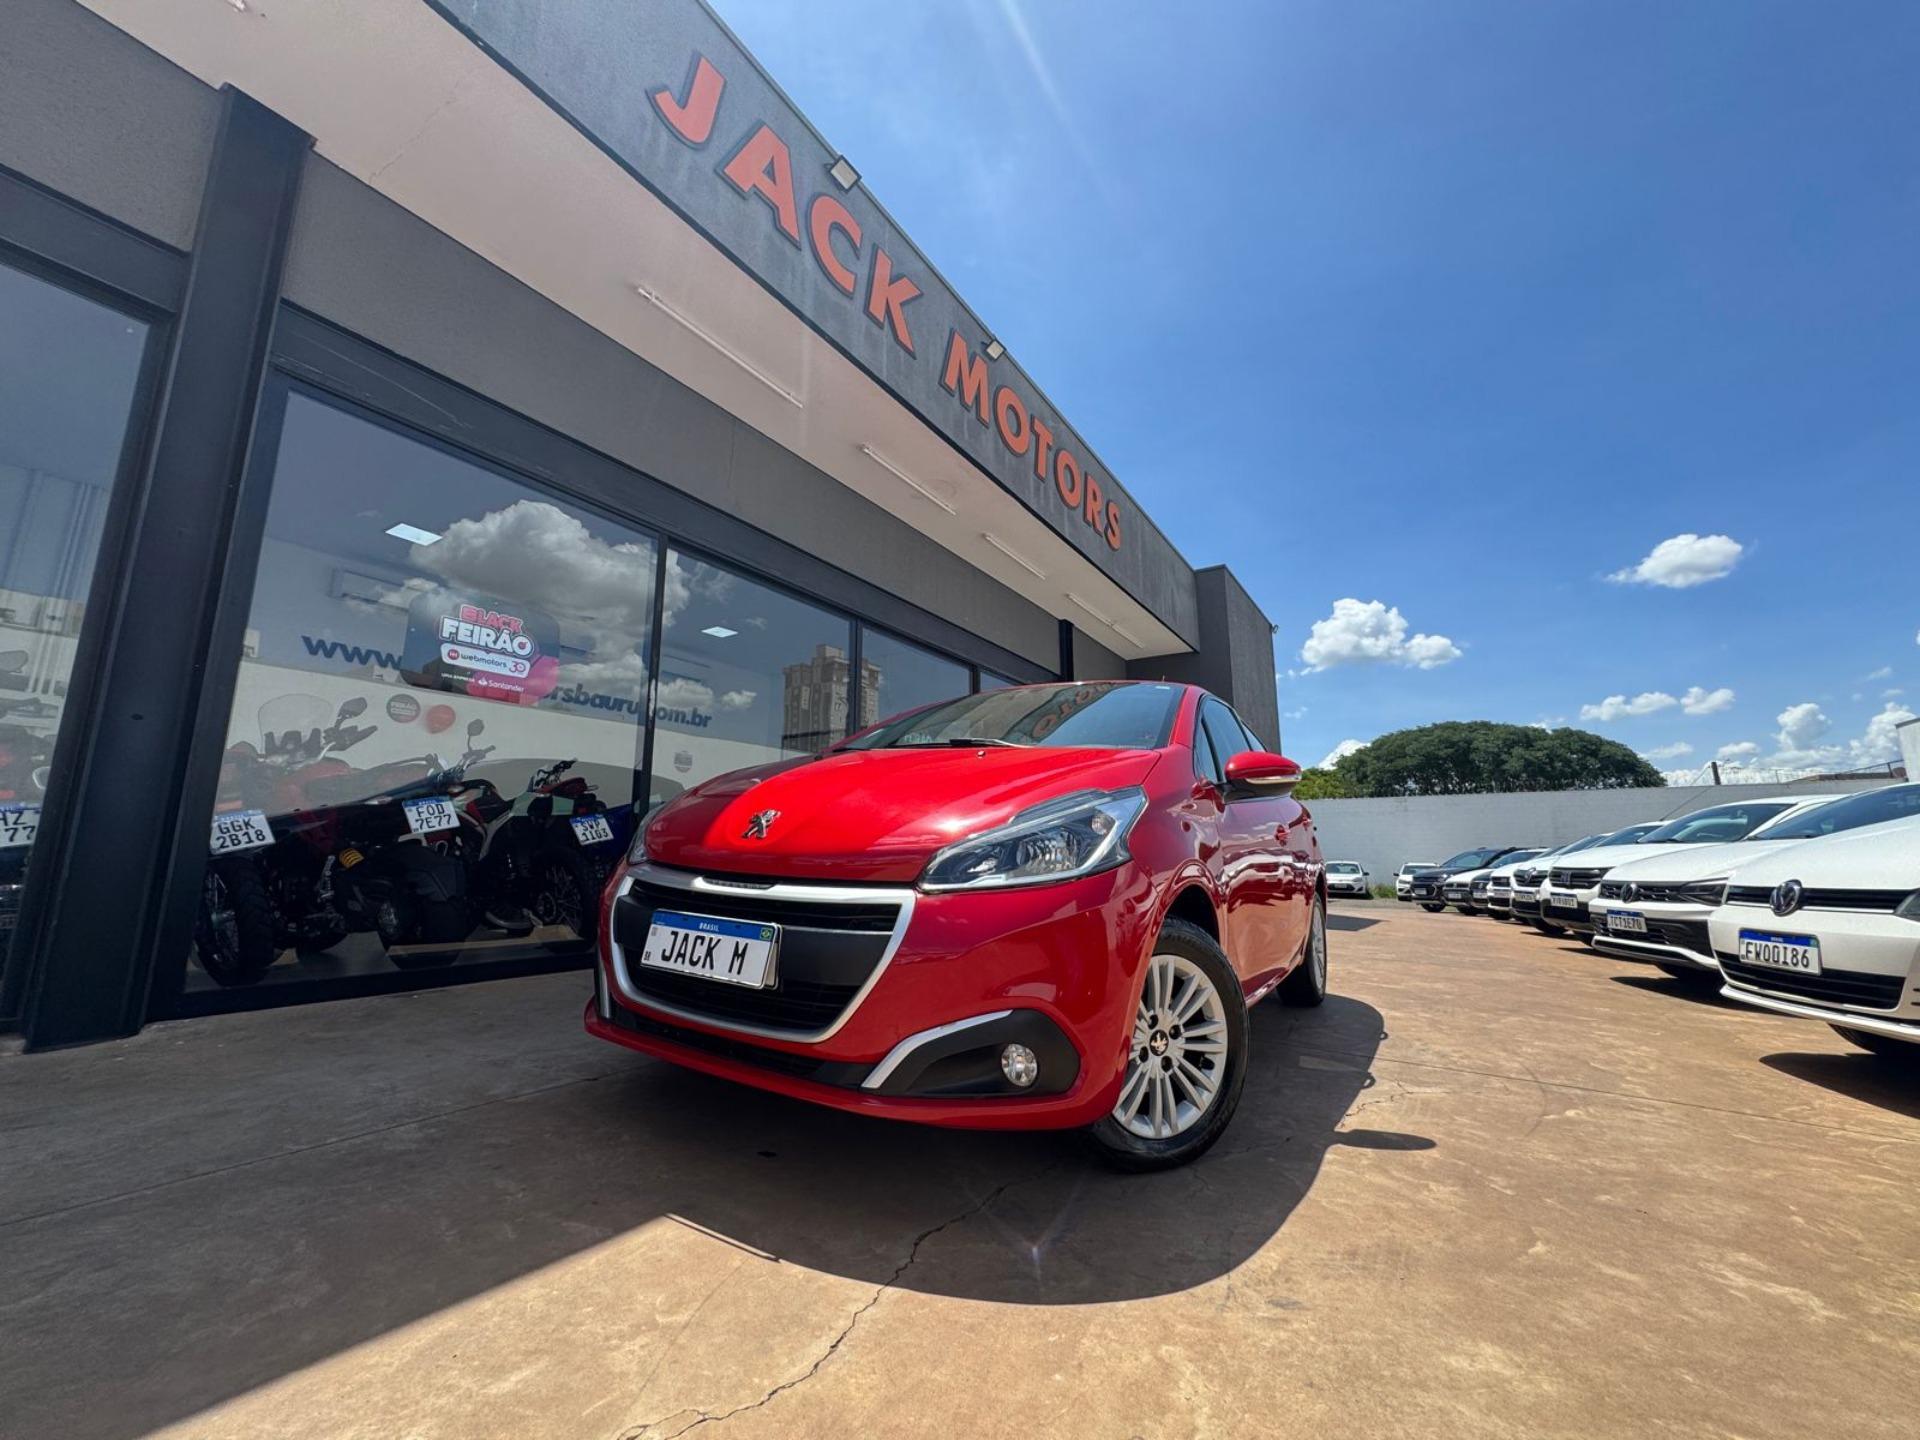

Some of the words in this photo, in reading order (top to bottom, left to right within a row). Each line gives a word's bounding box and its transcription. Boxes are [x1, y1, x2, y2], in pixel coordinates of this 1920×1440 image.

[648, 54, 924, 357] JACK
[939, 330, 1122, 550] MOTORS
[461, 605, 523, 634] BLACK
[442, 617, 533, 656] FEIRÃO
[461, 652, 507, 668] webmotors
[488, 680, 524, 692] Santander
[544, 683, 639, 714] rsbauru
[218, 817, 255, 835] GGK
[415, 814, 451, 830] 7E77
[216, 829, 266, 849] 2B18
[699, 922, 719, 932] BRASIL
[661, 930, 722, 970] JACK
[727, 940, 749, 975] M
